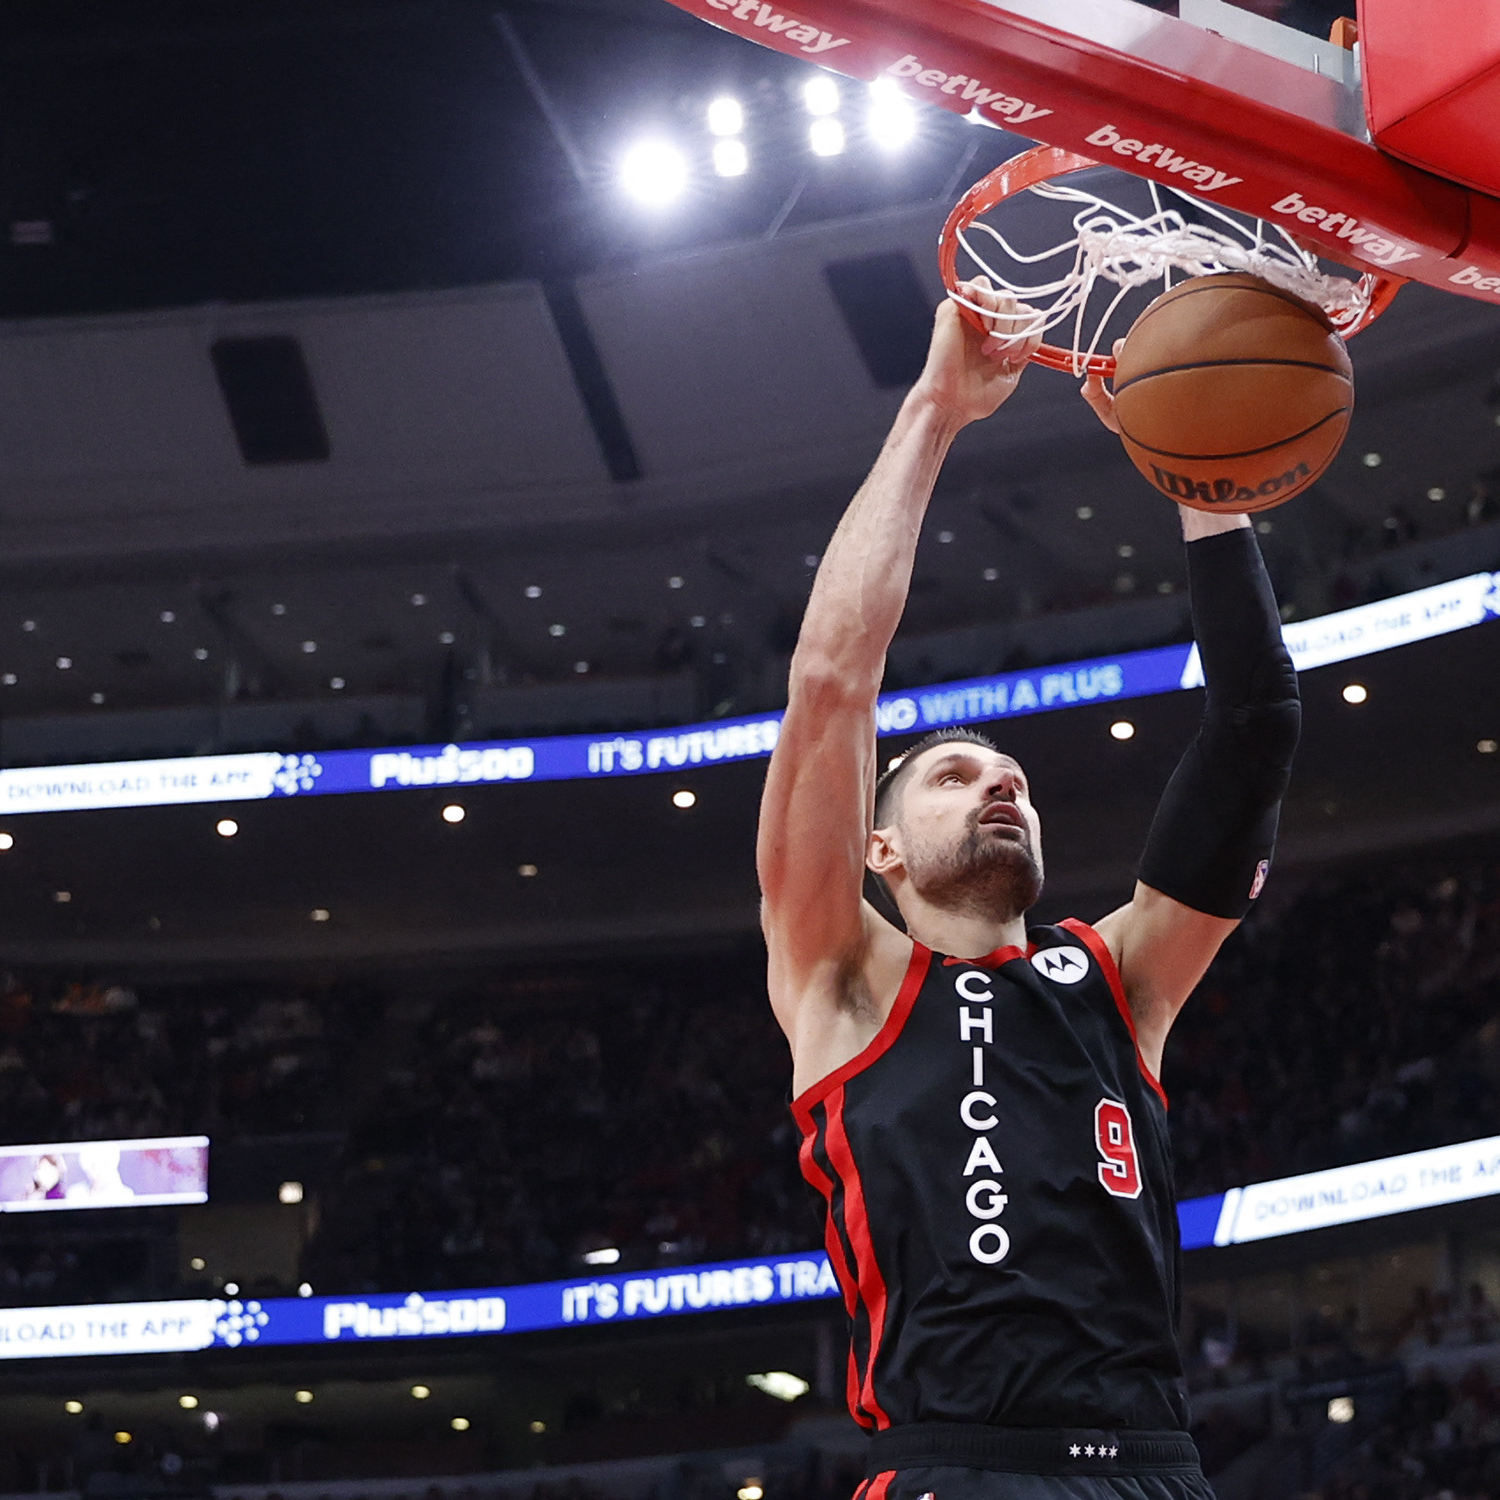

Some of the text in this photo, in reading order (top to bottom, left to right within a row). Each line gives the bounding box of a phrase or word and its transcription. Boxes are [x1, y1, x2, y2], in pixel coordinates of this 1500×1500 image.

[708, 0, 851, 52] etway
[886, 55, 1053, 124] betway
[1085, 124, 1243, 193] betway
[1271, 193, 1424, 266] betway
[1150, 462, 1311, 503] Wilson
[921, 684, 1012, 725] WITH
[1011, 680, 1039, 711] A
[1040, 664, 1123, 707] PLUS
[371, 744, 535, 788] Plus500
[588, 720, 779, 773] IT'S FUTURES
[158, 773, 201, 791] THE
[955, 971, 1010, 1264] CHICAGO
[1094, 1097, 1143, 1199] 9
[1418, 1163, 1463, 1189] THE
[323, 1292, 506, 1339] Plus500
[561, 1281, 620, 1323] IT'S
[623, 1265, 774, 1316] FUTURES
[87, 1320, 130, 1339] THE
[141, 1317, 192, 1336] APP
